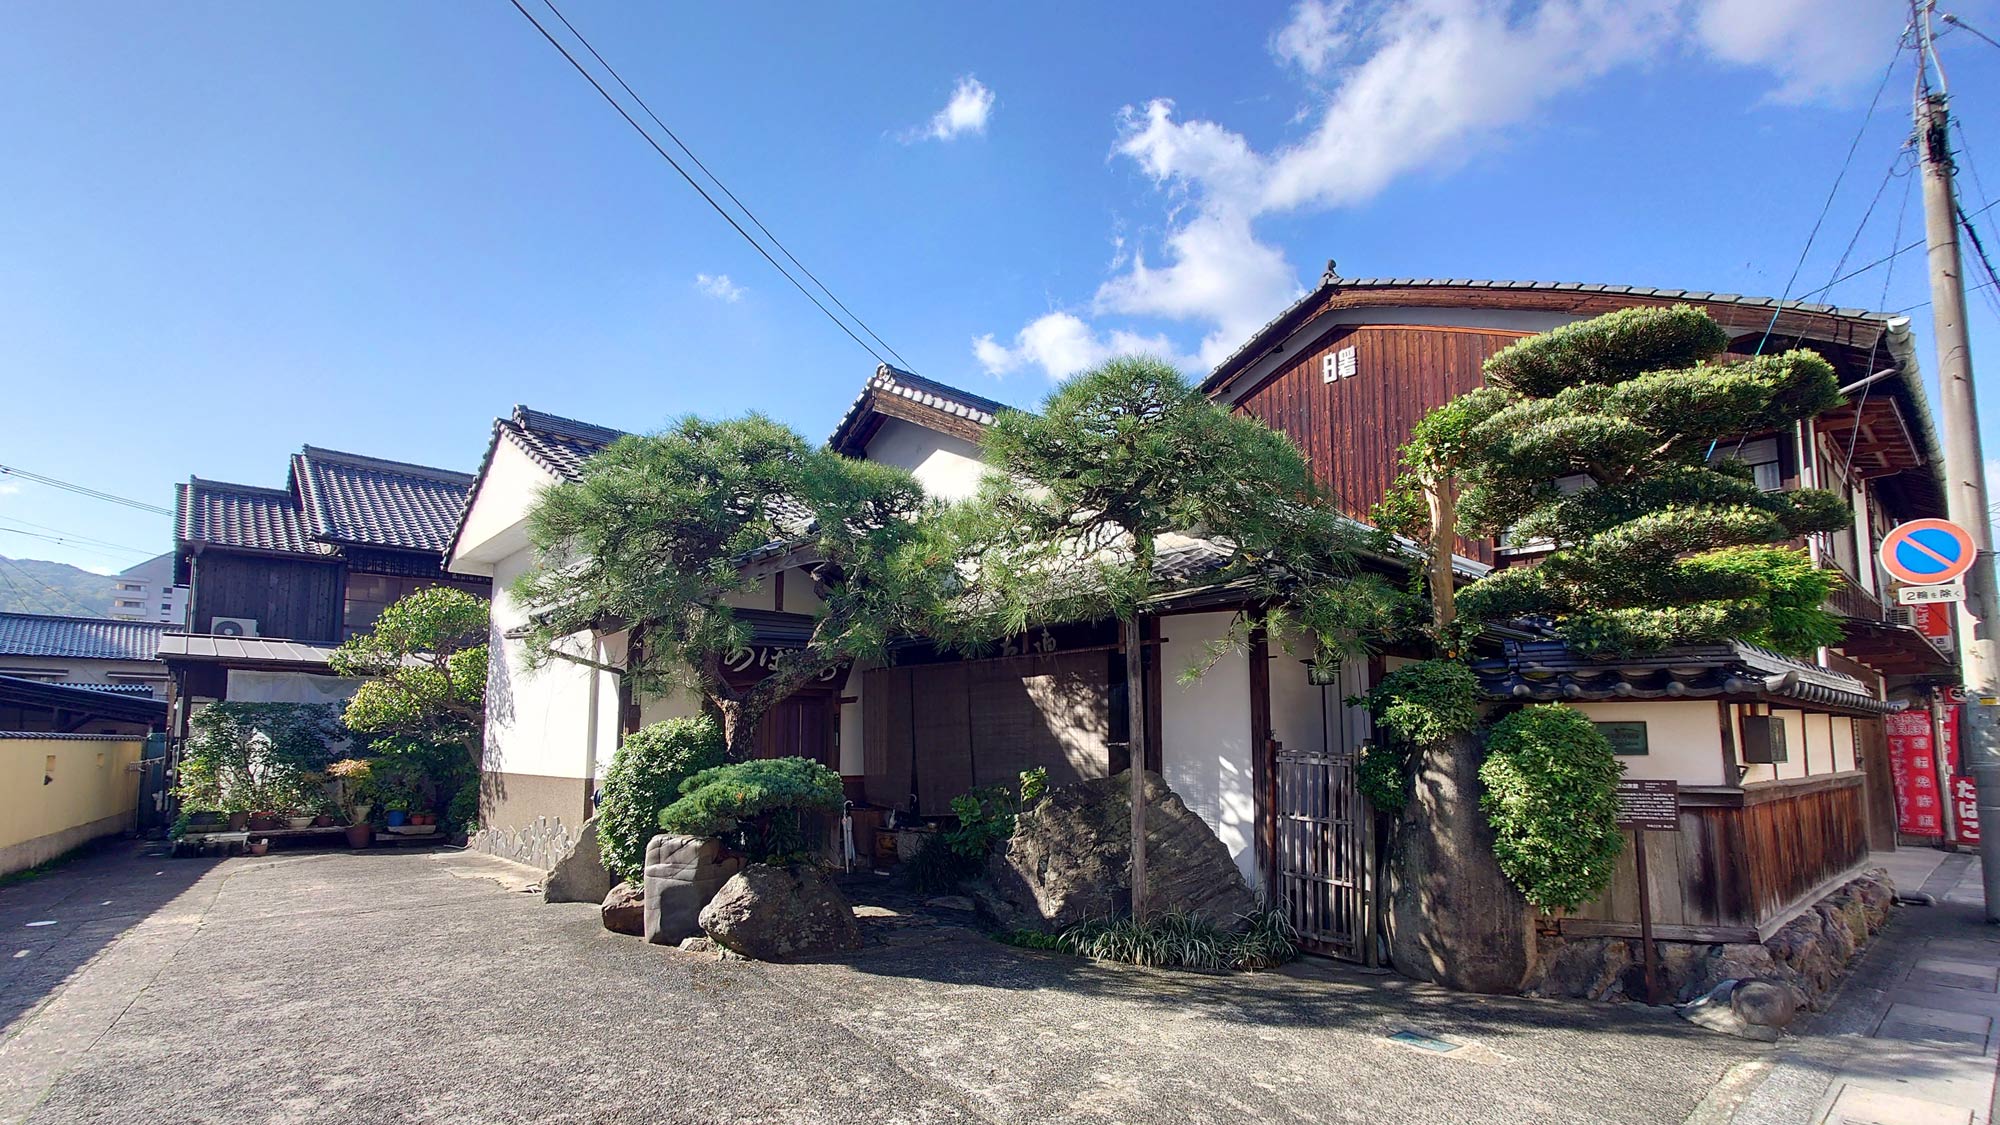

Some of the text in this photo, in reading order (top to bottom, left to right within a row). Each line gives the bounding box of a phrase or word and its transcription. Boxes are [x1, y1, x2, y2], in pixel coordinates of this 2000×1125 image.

[1322, 345, 1357, 384] 曙
[1905, 588, 1960, 601] 2輪を除く
